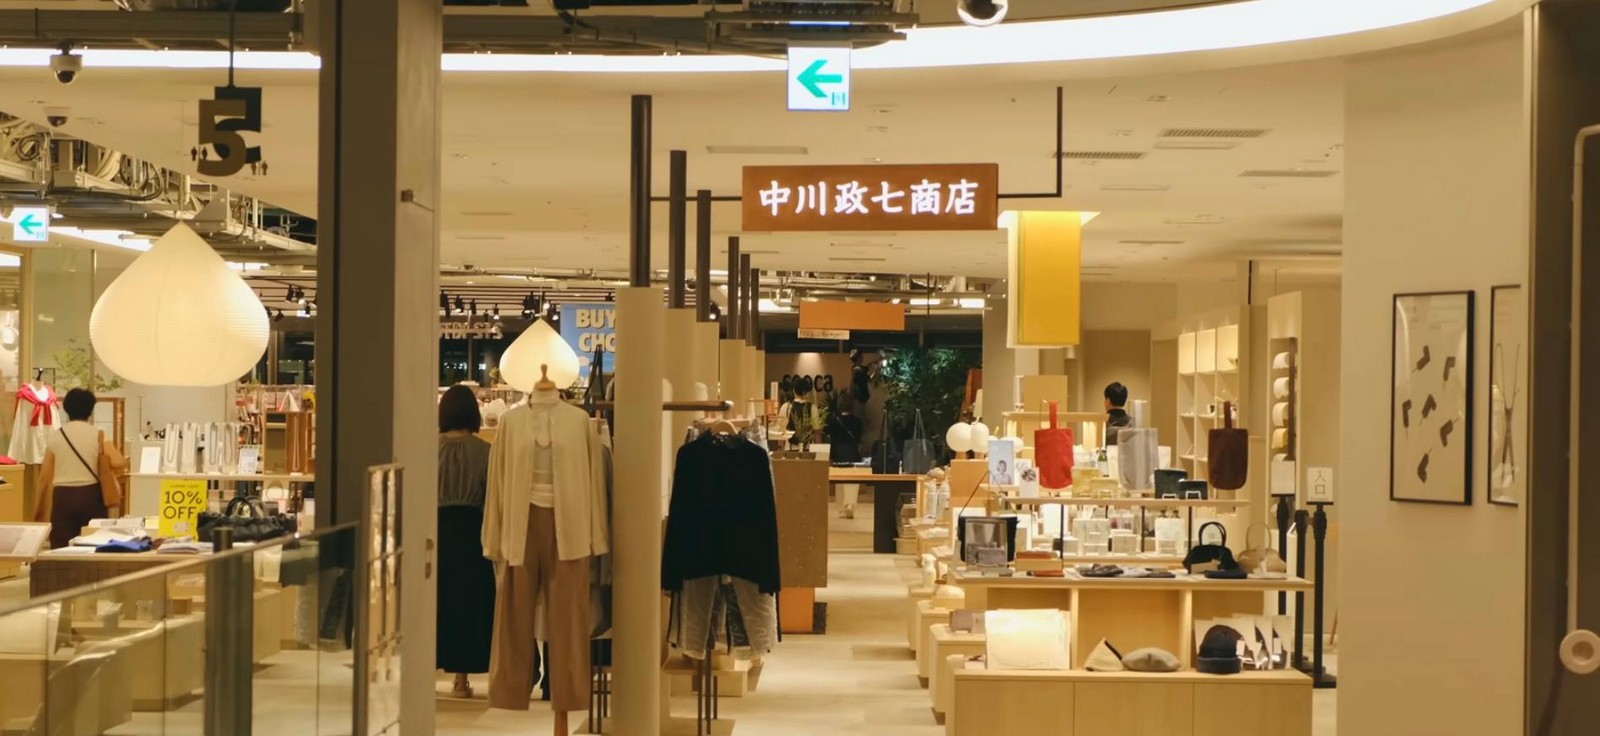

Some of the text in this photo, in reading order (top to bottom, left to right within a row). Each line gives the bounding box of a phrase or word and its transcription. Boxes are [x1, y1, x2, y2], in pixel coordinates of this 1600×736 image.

[197, 99, 248, 176] 5
[758, 179, 979, 216] 中川政七商店
[576, 308, 615, 328] BUY
[782, 374, 833, 392] oca
[1314, 471, 1327, 494] 入口
[164, 490, 203, 504] 10%
[163, 506, 198, 519] OFF
